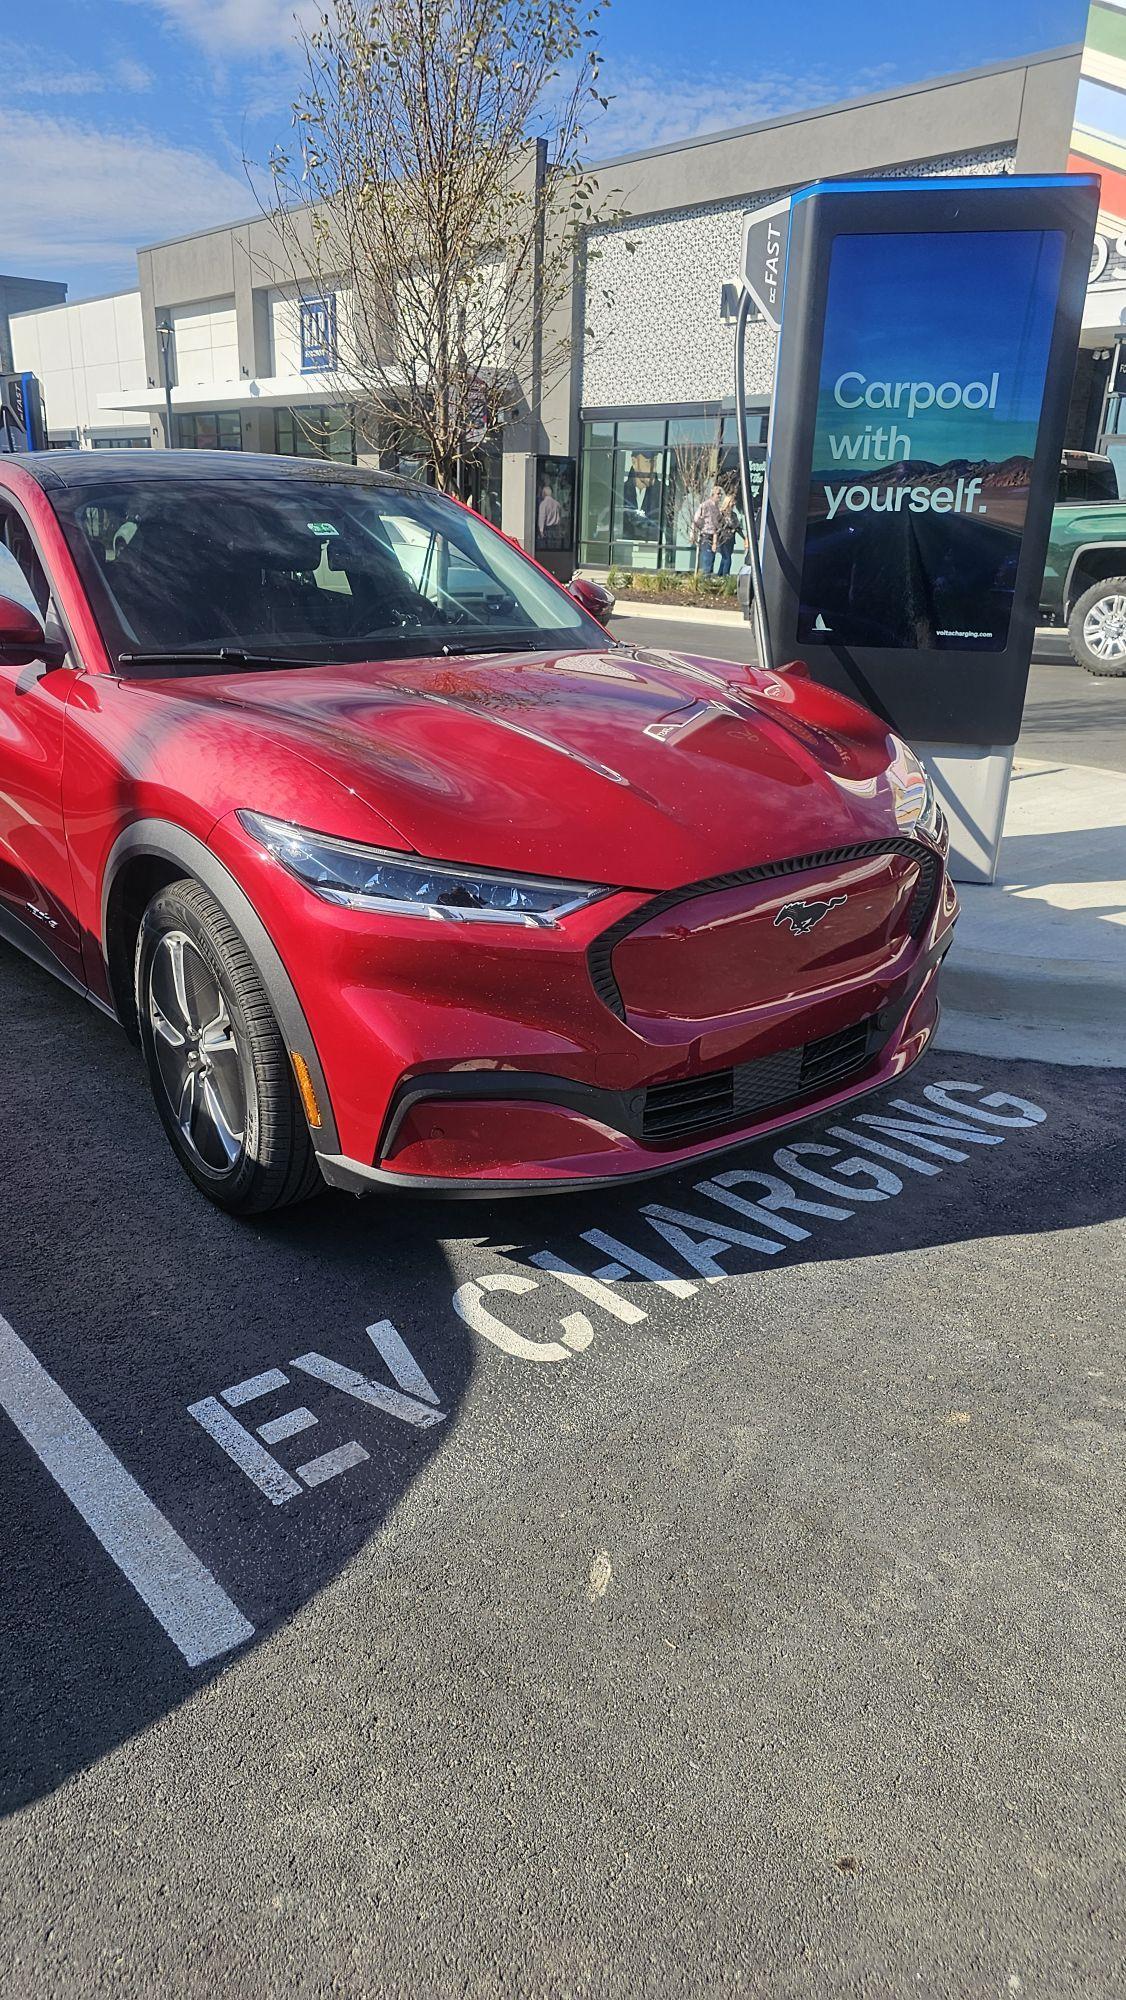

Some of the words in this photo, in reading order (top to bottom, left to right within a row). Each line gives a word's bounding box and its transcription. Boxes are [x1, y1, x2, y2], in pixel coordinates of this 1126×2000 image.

[765, 222, 781, 286] FAST
[834, 371, 1000, 419] Carpool
[828, 425, 911, 461] with
[823, 477, 987, 520] yourself.
[935, 629, 993, 639] voltacharging.com
[186, 1318, 447, 1506] EV
[452, 1080, 1048, 1362] CHARGING
